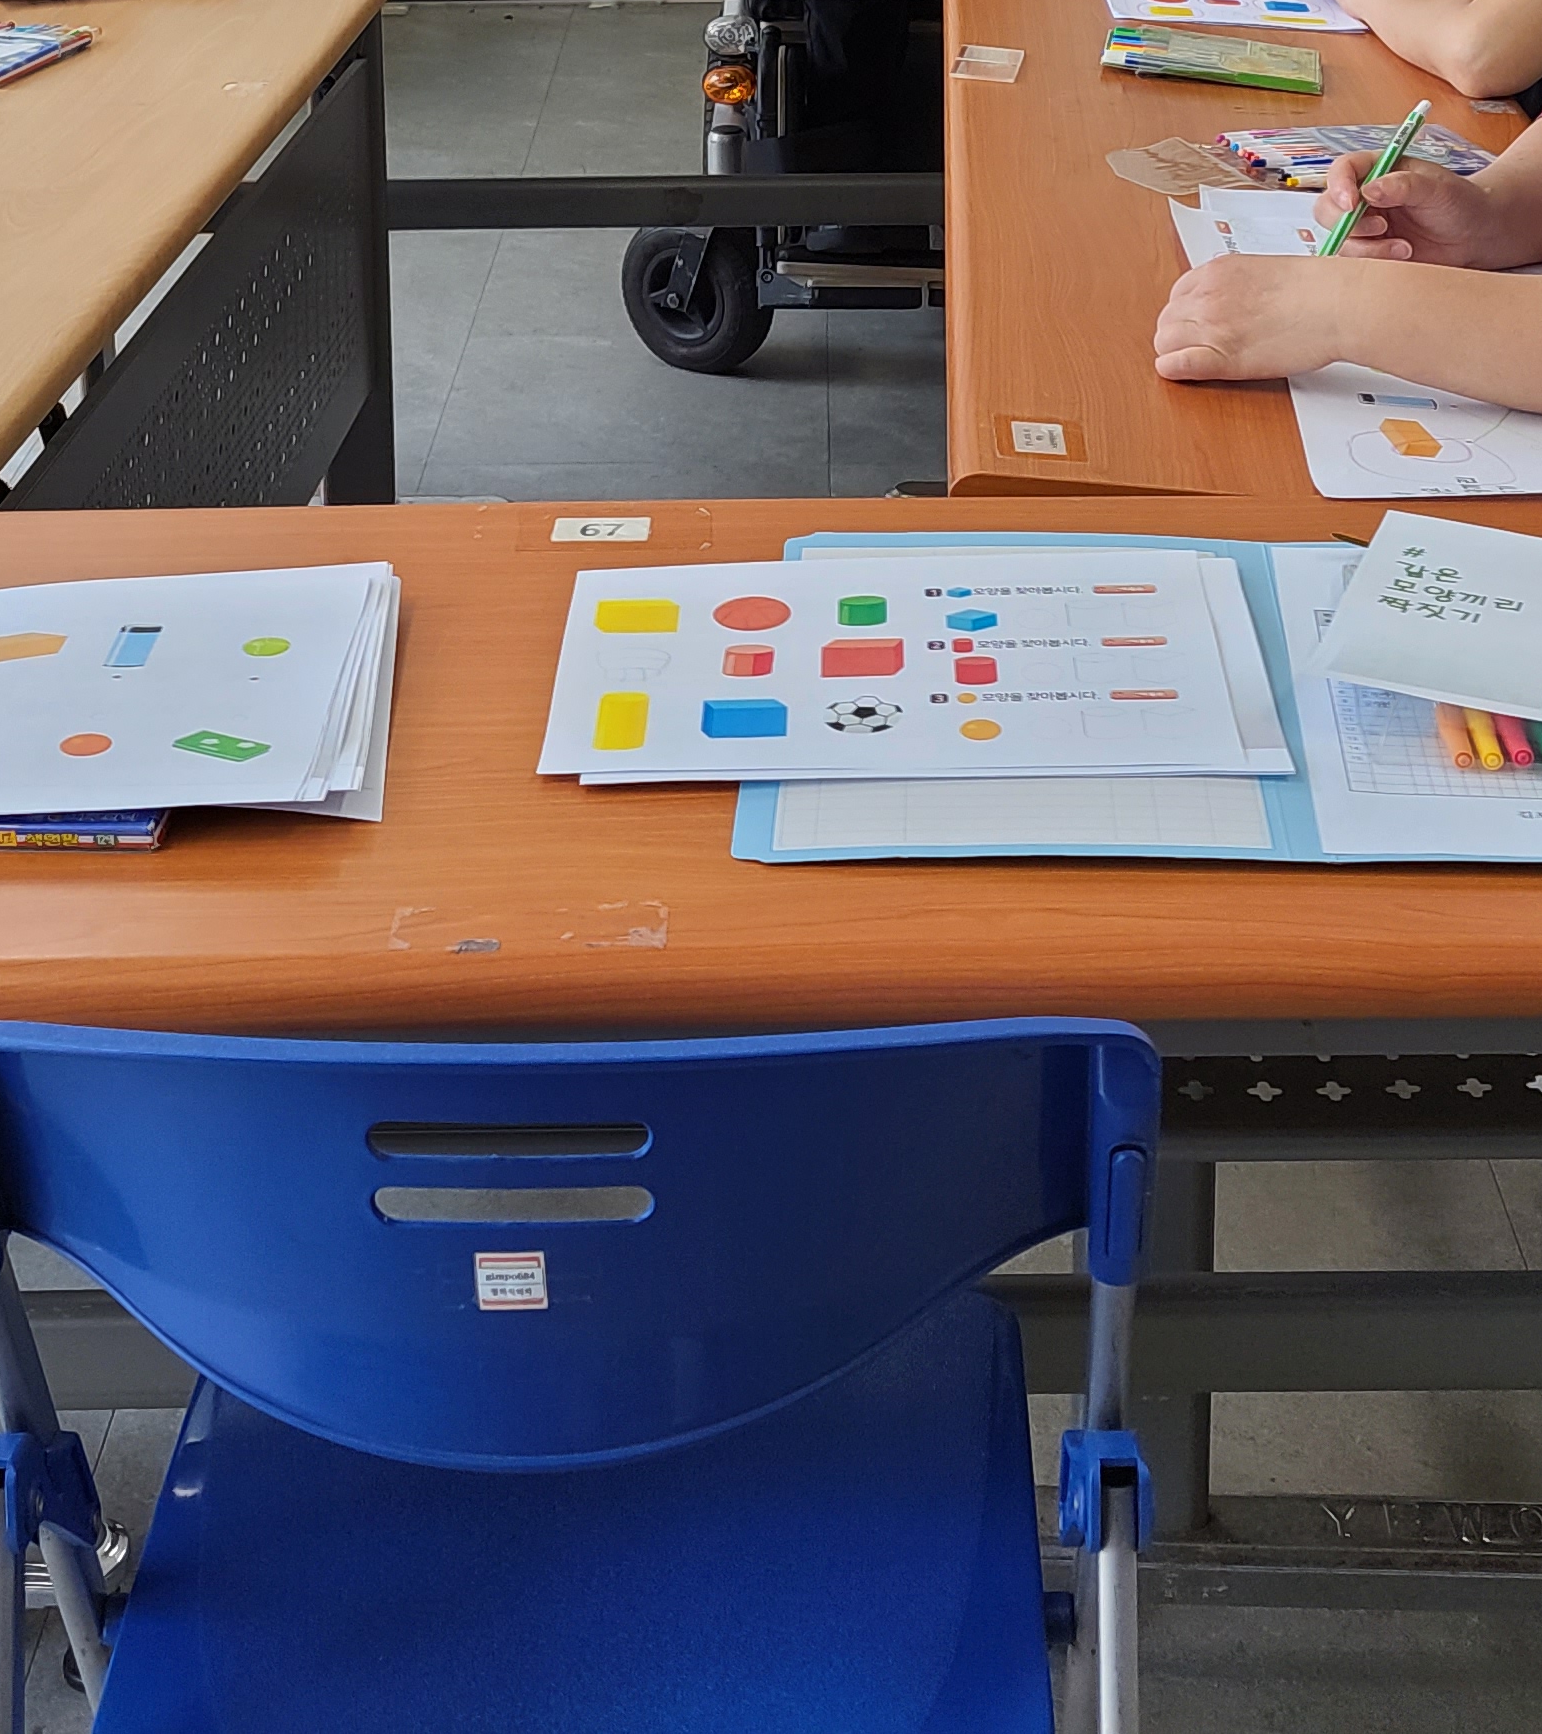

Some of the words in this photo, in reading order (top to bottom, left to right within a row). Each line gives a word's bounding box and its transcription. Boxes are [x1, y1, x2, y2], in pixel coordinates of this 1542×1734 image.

[580, 522, 627, 537] 67
[973, 586, 1012, 596] 모양을
[1015, 585, 1084, 596] 찾아봅시다.
[1385, 578, 1525, 612] 모양끼리
[1377, 594, 1482, 623] 짝짓기
[977, 639, 1017, 649] 모양을
[1021, 638, 1092, 648] 찾아봅시다.
[982, 692, 1023, 702] 모양을
[1026, 691, 1101, 702] 찾아봅시다.
